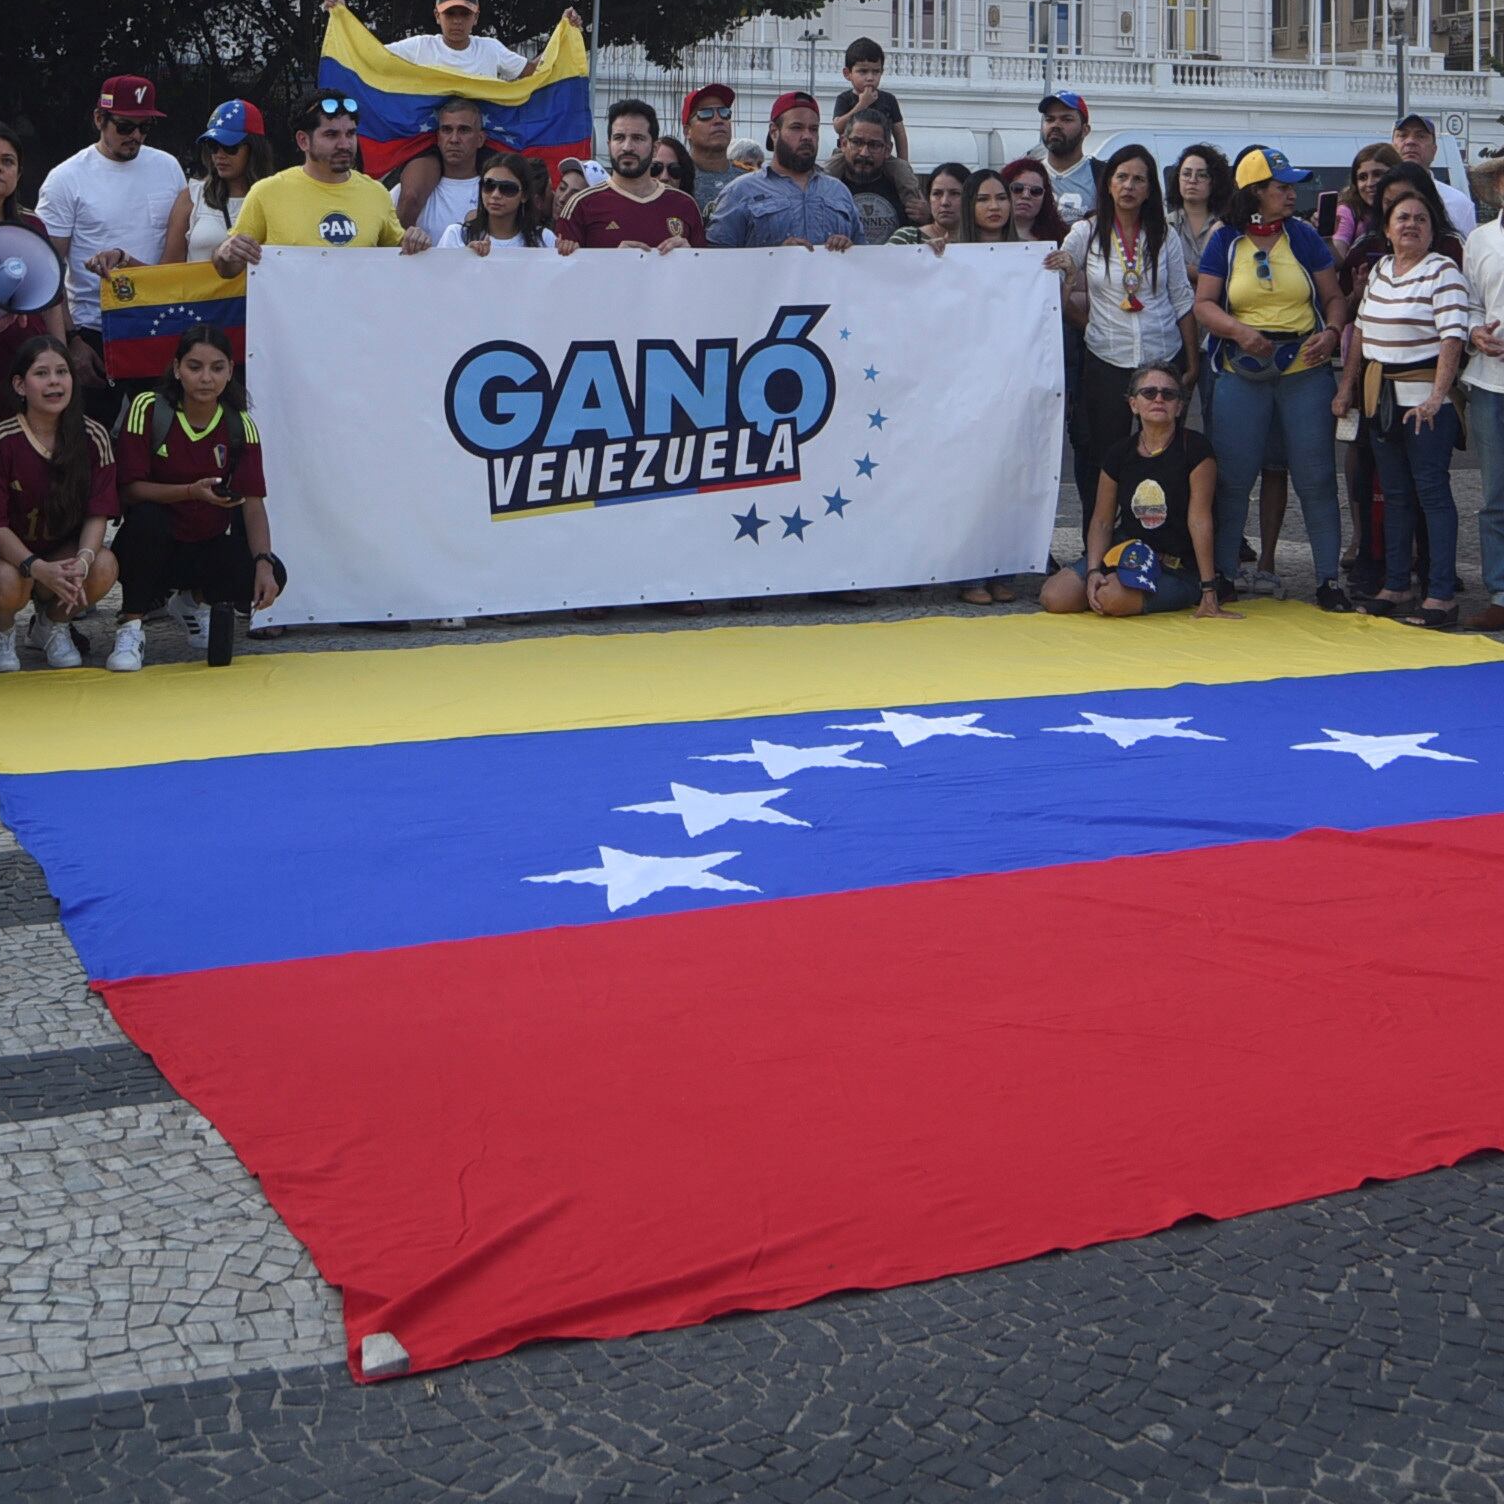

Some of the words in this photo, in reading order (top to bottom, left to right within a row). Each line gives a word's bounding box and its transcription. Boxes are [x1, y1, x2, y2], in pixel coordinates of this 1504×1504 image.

[319, 221, 357, 239] PAN
[451, 312, 830, 452] GANÓ
[491, 422, 796, 507] VENEZUELA
